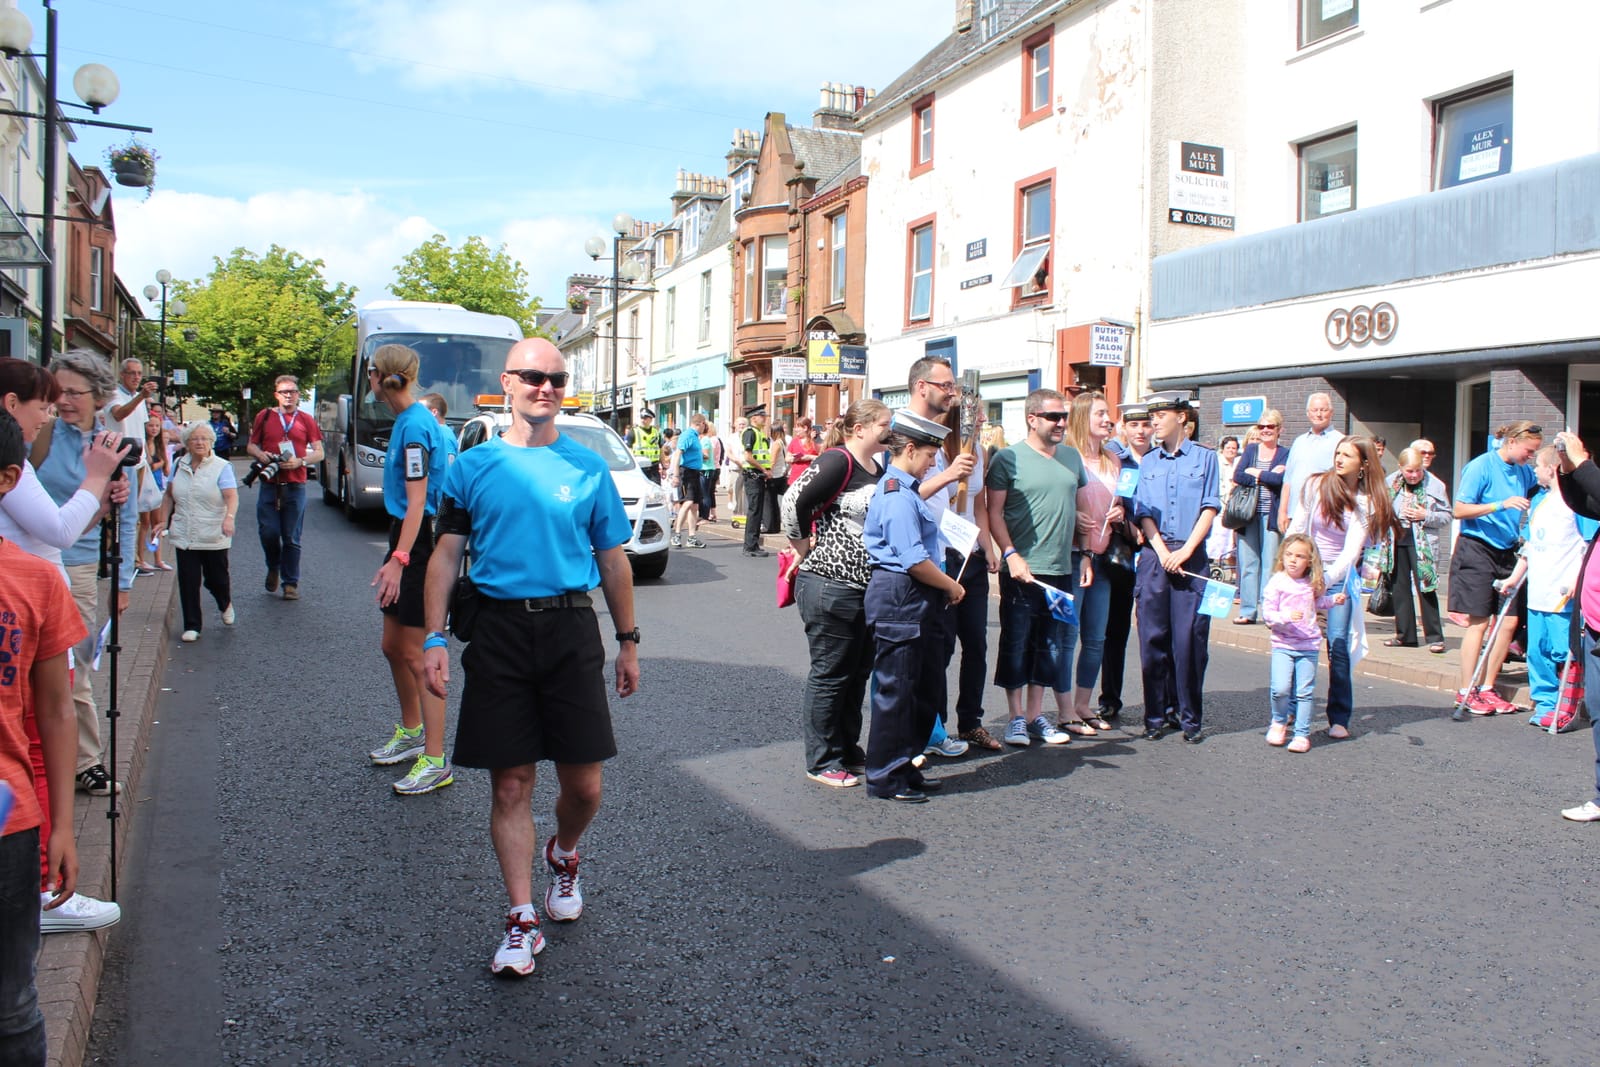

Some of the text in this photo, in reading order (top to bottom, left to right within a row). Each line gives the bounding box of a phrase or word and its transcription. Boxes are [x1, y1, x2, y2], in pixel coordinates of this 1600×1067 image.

[1472, 130, 1493, 142] ALEX
[1471, 140, 1492, 152] MUIR
[1190, 152, 1216, 162] ALEX
[1189, 160, 1216, 171] MUIR
[1175, 174, 1229, 189] SOLICITOR
[1186, 212, 1232, 227] 01294 311422
[1095, 327, 1123, 335] RUTH'S
[1331, 309, 1393, 342] TSB
[810, 332, 840, 340] FOR SA
[1095, 343, 1122, 351] SALON
[0, 611, 16, 625] 82
[0, 666, 16, 686] 9
